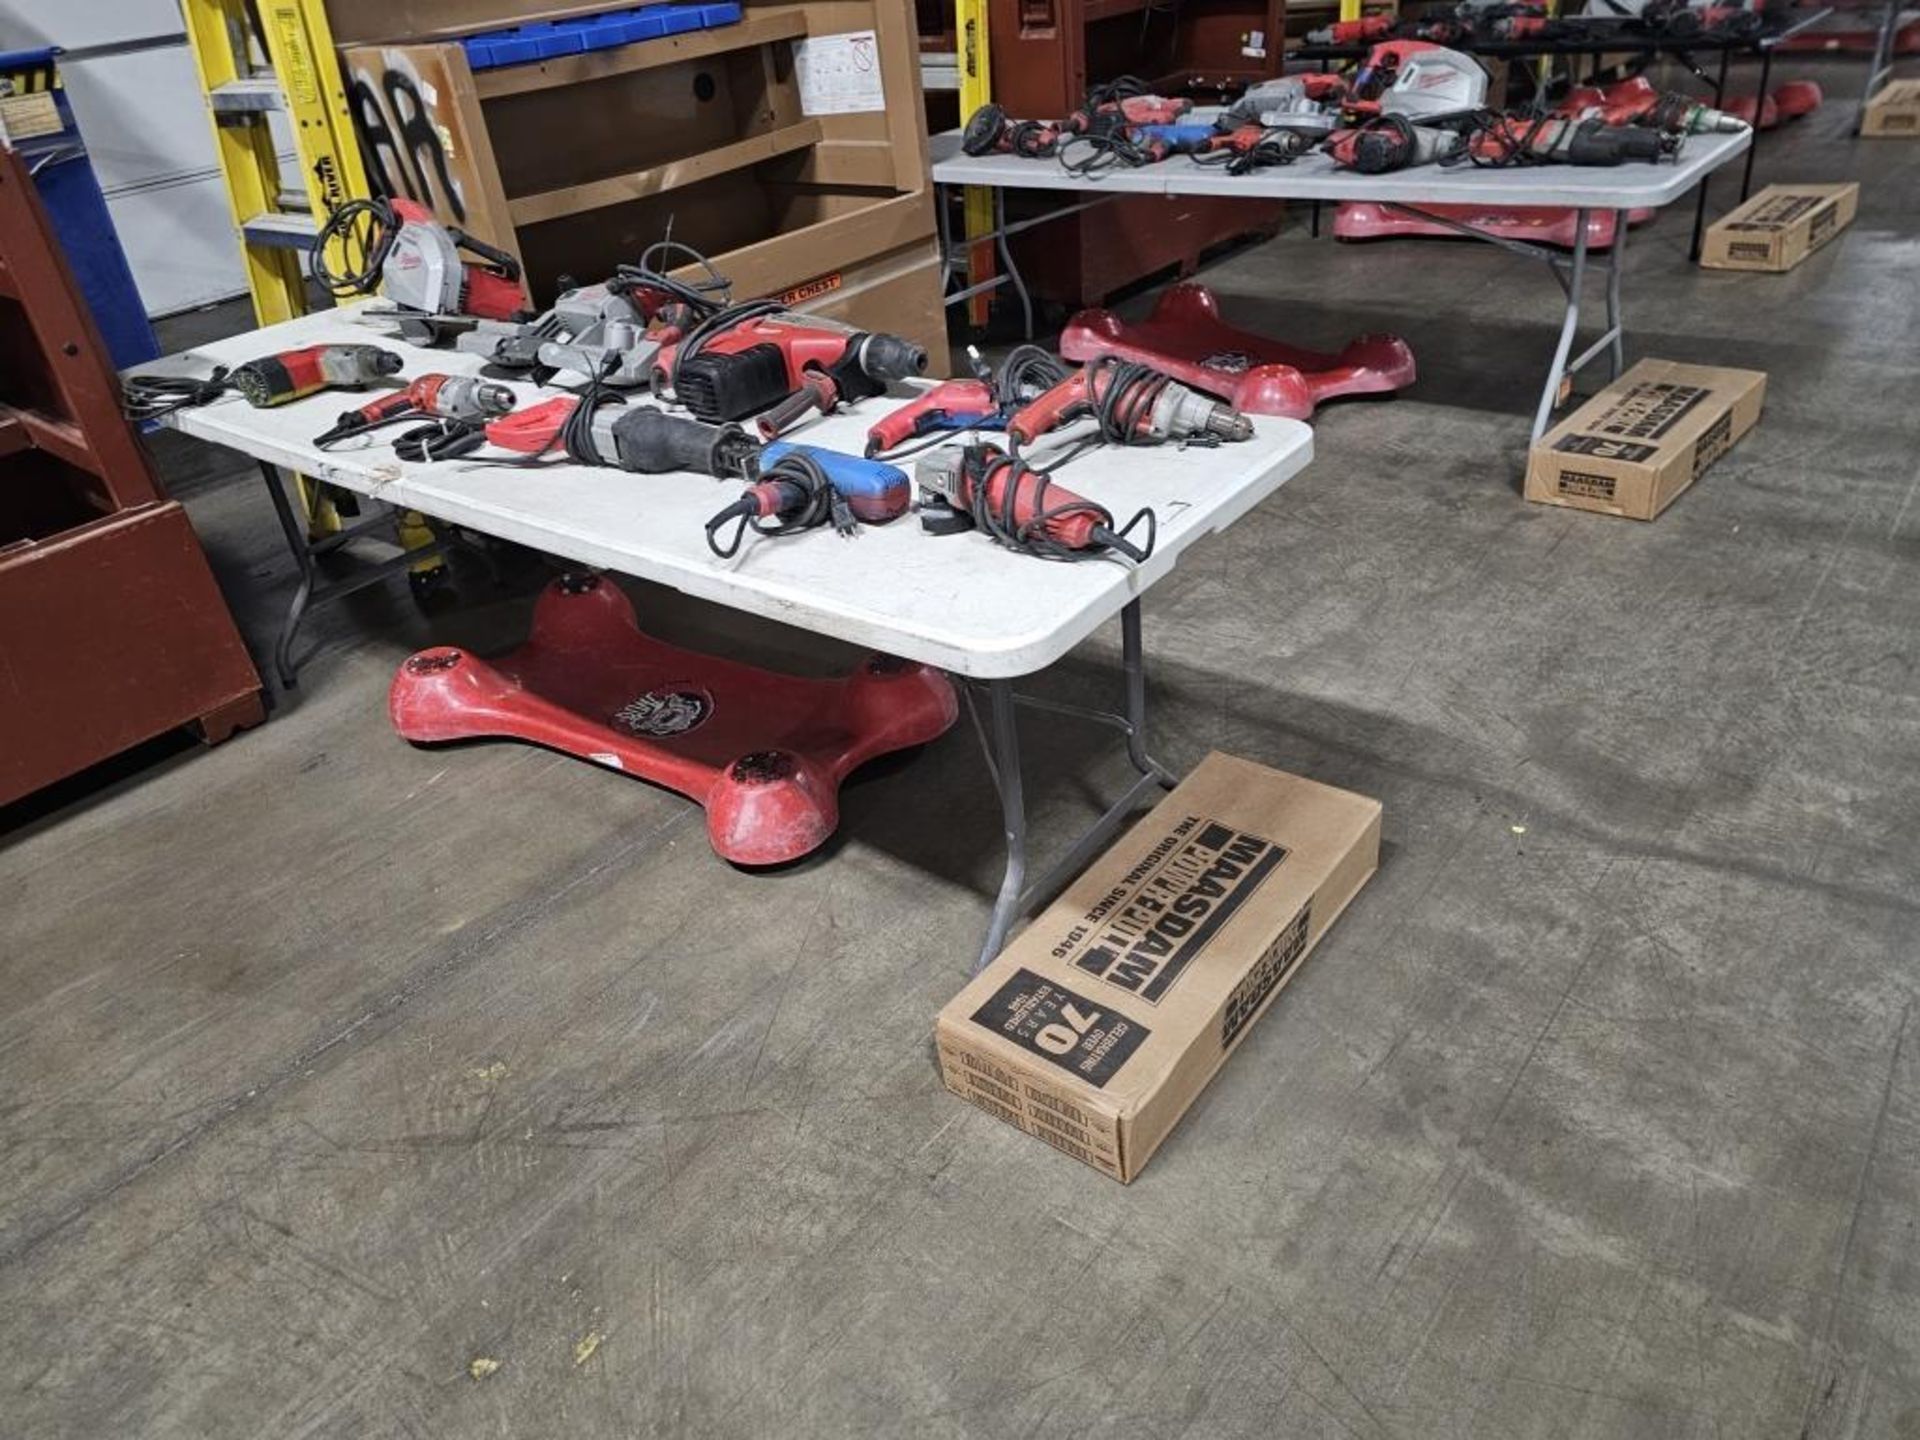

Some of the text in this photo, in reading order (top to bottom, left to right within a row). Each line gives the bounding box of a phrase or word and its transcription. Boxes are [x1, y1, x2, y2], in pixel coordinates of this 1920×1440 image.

[797, 276, 837, 298] CHEST
[1592, 442, 1626, 456] 70
[1048, 815, 1200, 959] THE ORIGINAL SINCE 1946
[1104, 834, 1268, 992] MAASDAM
[1014, 990, 1065, 1038] YEARS
[1029, 999, 1102, 1058] 70
